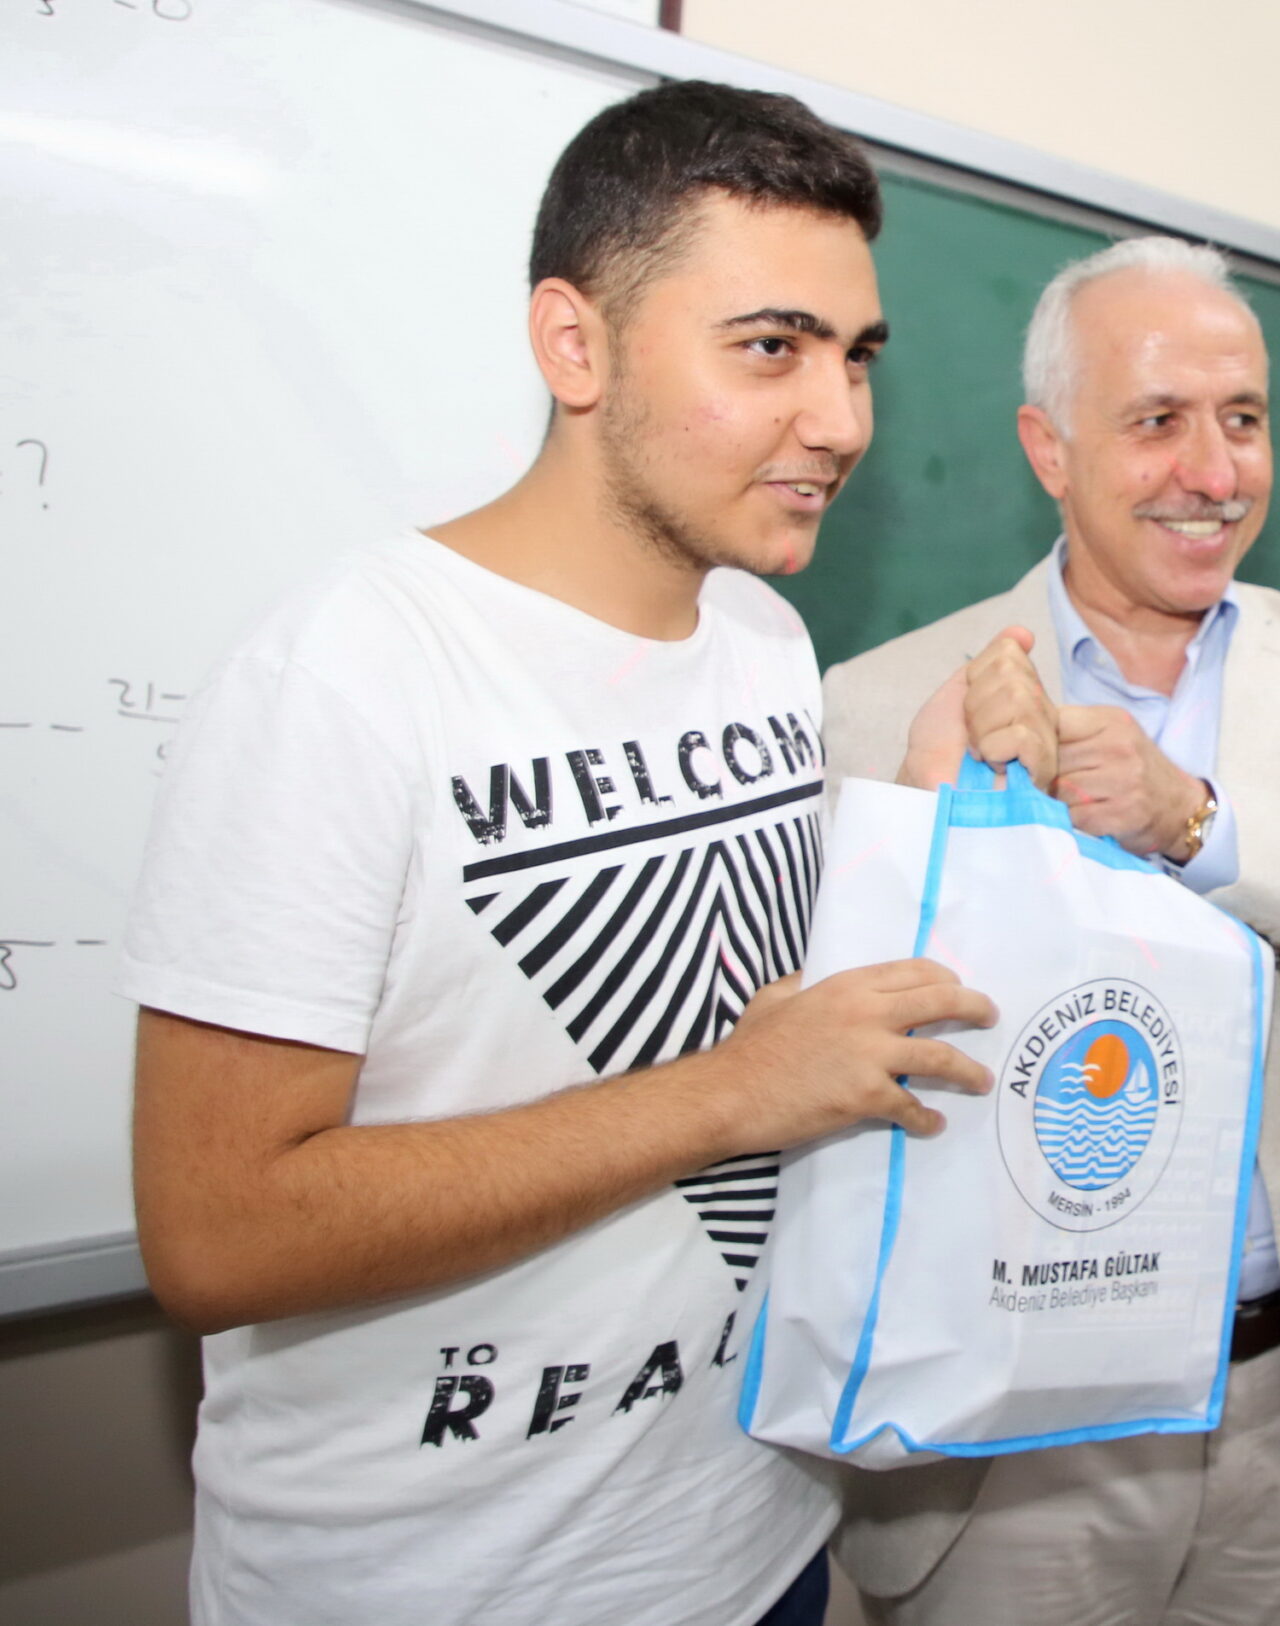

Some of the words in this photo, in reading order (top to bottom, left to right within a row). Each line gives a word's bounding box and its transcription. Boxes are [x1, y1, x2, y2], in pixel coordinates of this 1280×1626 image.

[451, 708, 825, 847] WELCOM
[1009, 992, 1096, 1099] AKDENİZ
[1104, 989, 1181, 1105] BELEDİYESİ
[992, 1259, 1012, 1285] M.
[1021, 1258, 1098, 1287] MUSTAFA
[1104, 1250, 1161, 1278] GÜLTAK
[989, 1286, 1046, 1313] Akdeniz
[1049, 1282, 1107, 1309] Belediye
[440, 1343, 498, 1370] TO
